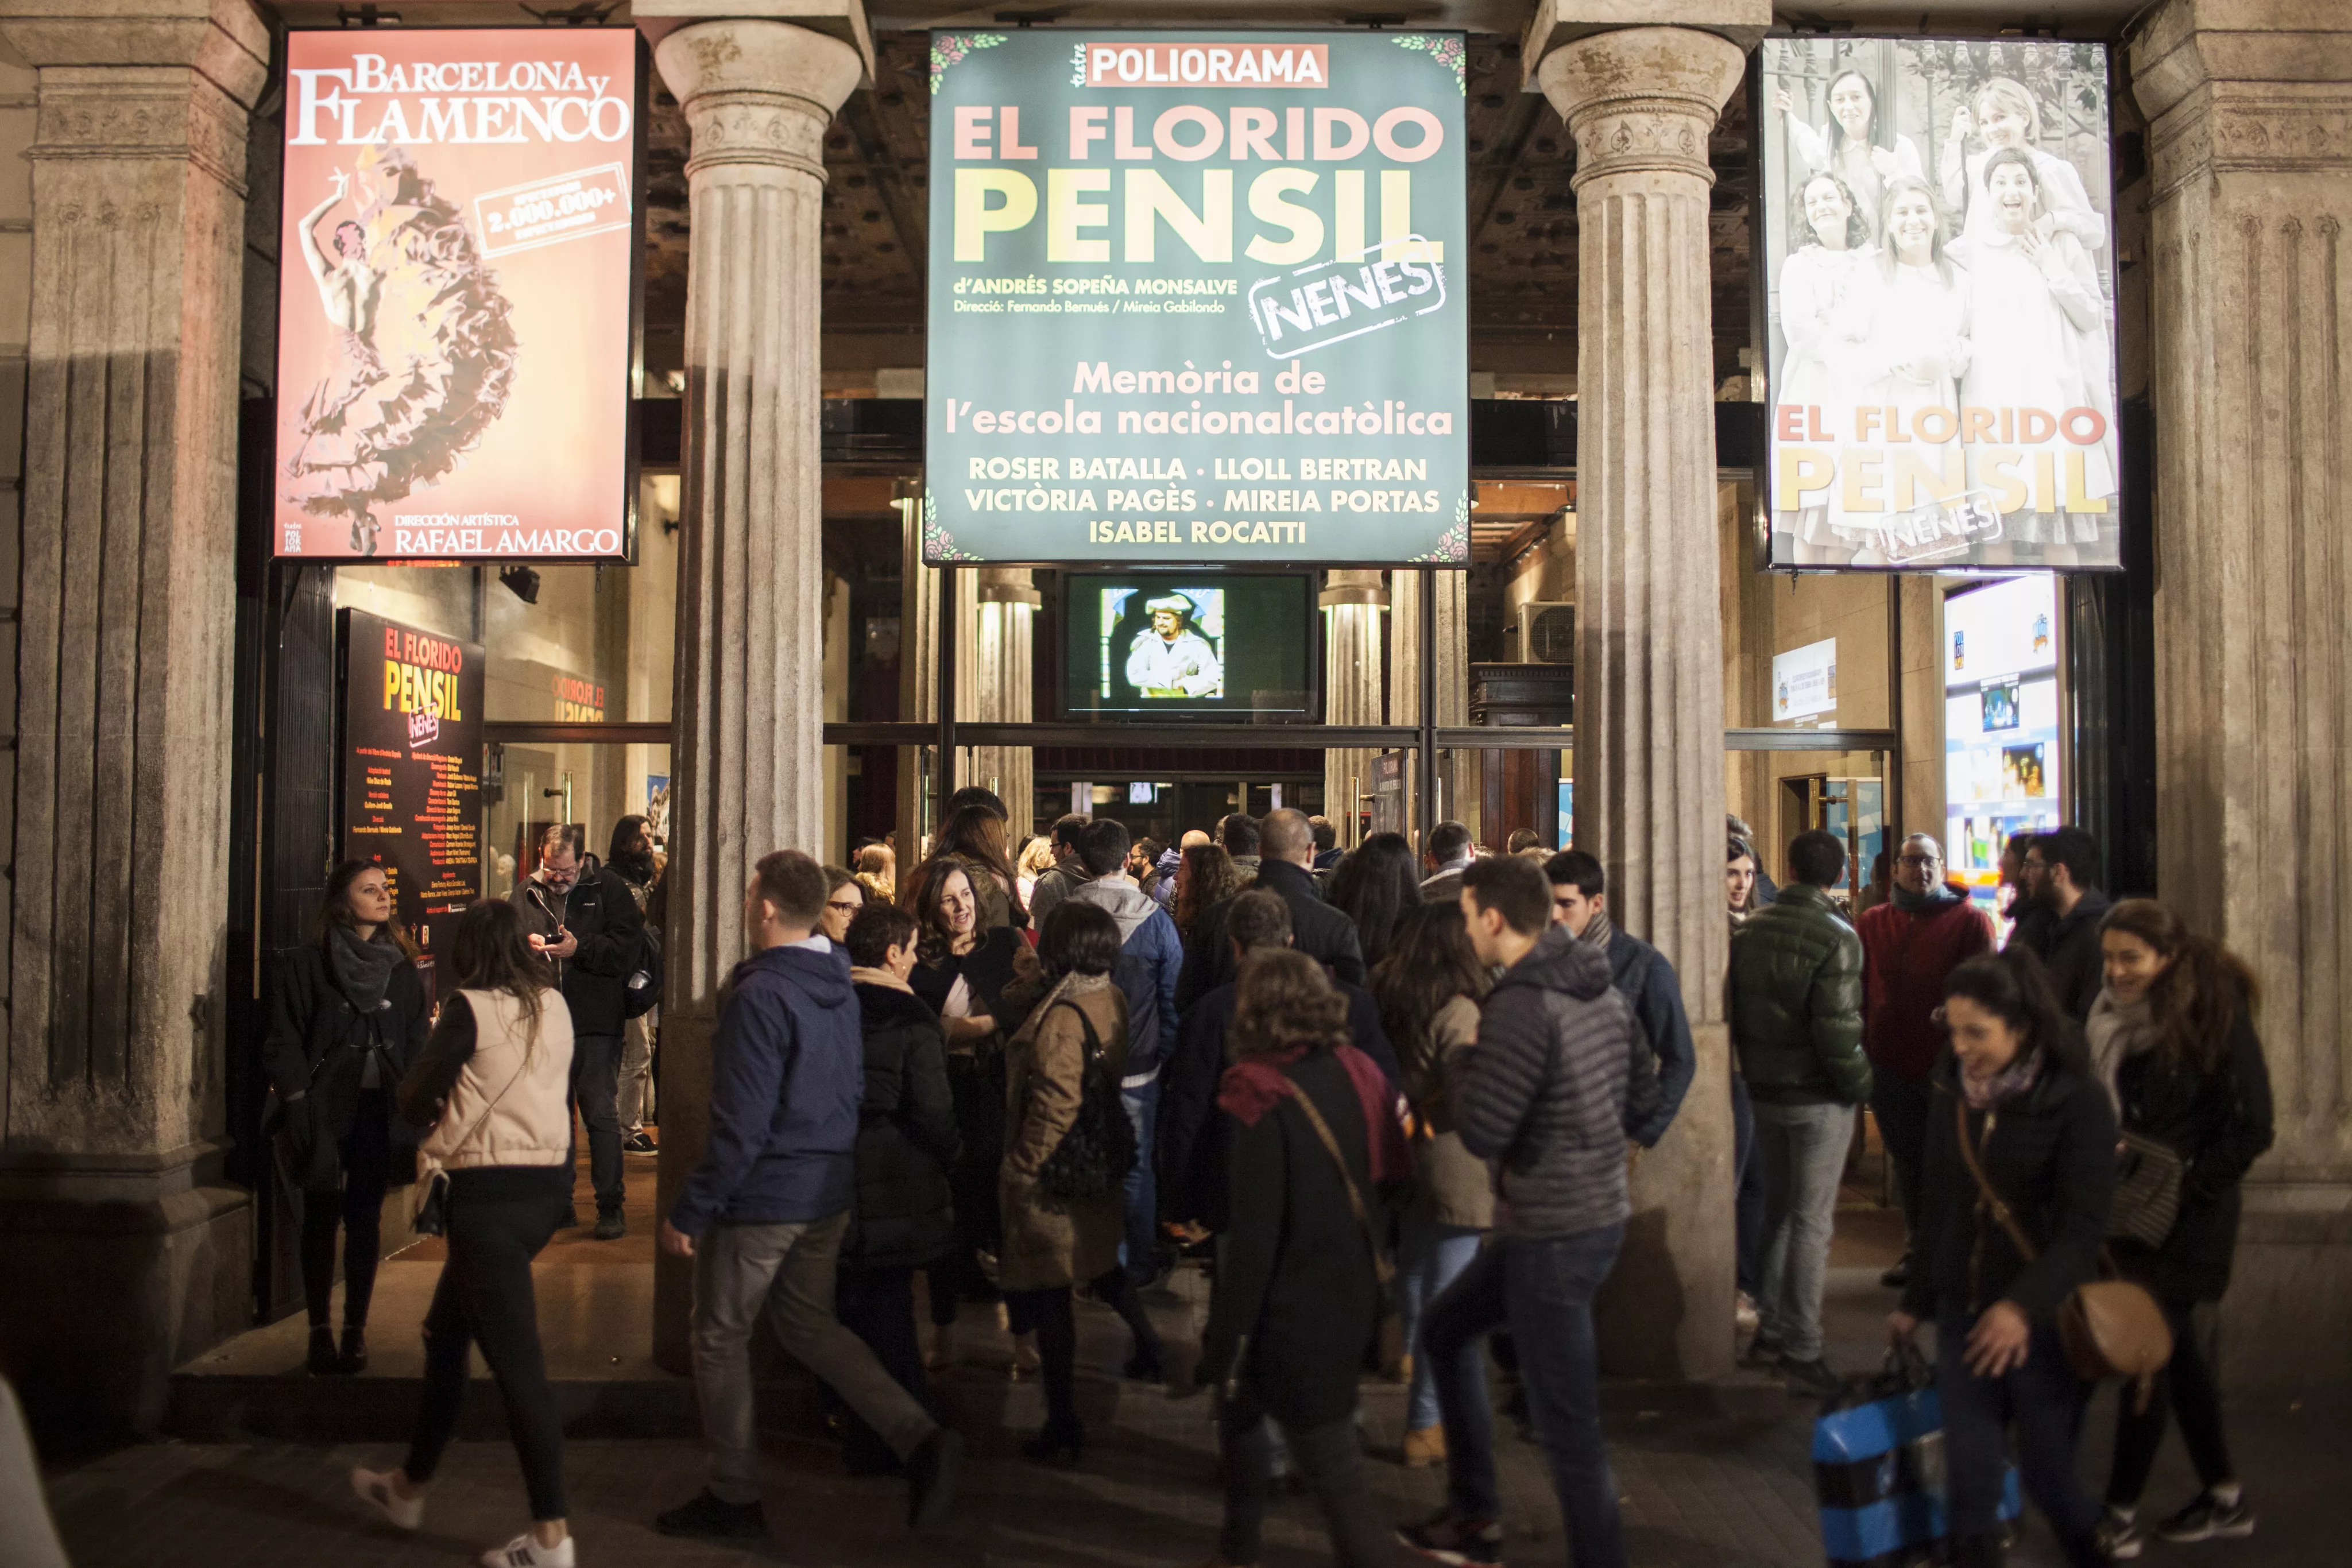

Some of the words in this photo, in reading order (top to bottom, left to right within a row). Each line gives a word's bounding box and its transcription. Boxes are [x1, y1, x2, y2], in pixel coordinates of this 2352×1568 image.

[349, 53, 589, 92] BARCELONA
[1070, 42, 1087, 87] teatre
[1092, 48, 1323, 82] POLIORAMA
[288, 68, 632, 145] FLAMENCO
[954, 106, 1038, 160] EL
[1069, 104, 1444, 162] FLORIDO
[487, 187, 617, 234] 2.000.000+
[953, 167, 1444, 265] PENSIL
[1052, 274, 1129, 295] SOPEÑA
[1134, 279, 1237, 295] MONSALVE
[1260, 251, 1433, 342] NENES
[953, 300, 1004, 313] Direcció:
[1007, 300, 1062, 313] Fernando
[1065, 300, 1109, 313] Bernués
[1123, 300, 1161, 313] Mireia
[1163, 300, 1225, 314] Gabilondo
[1073, 359, 1259, 394] Memòria
[1275, 359, 1326, 394] de
[1118, 400, 1452, 435] nacionalcatòlica
[1777, 404, 1834, 442] EL
[1855, 405, 2106, 445] FLORIDO
[969, 457, 1060, 480] ROSER
[1069, 458, 1187, 480] BATALLA
[1214, 458, 1291, 481] LLOLL
[1300, 459, 1426, 481] BERTRAN
[1780, 447, 2108, 514] PENSIL
[965, 482, 1098, 512] VICTÒRIA
[1107, 482, 1197, 512] PAGÈS
[1224, 490, 1321, 512] MIREIA
[1331, 490, 1440, 513] PORTAS
[394, 512, 459, 526] DIRECCIÓN
[461, 512, 520, 526] ARTÍSTICA
[1090, 521, 1182, 543] ISABEL
[1191, 521, 1306, 544] ROCATTI
[1886, 498, 1995, 552] NENES
[395, 529, 492, 553] RAFAEL
[495, 529, 619, 553] AMARGO
[385, 628, 400, 659] EL
[404, 633, 462, 673] FLORIDO
[384, 660, 462, 722] PENSIL
[410, 713, 437, 738] NENES
